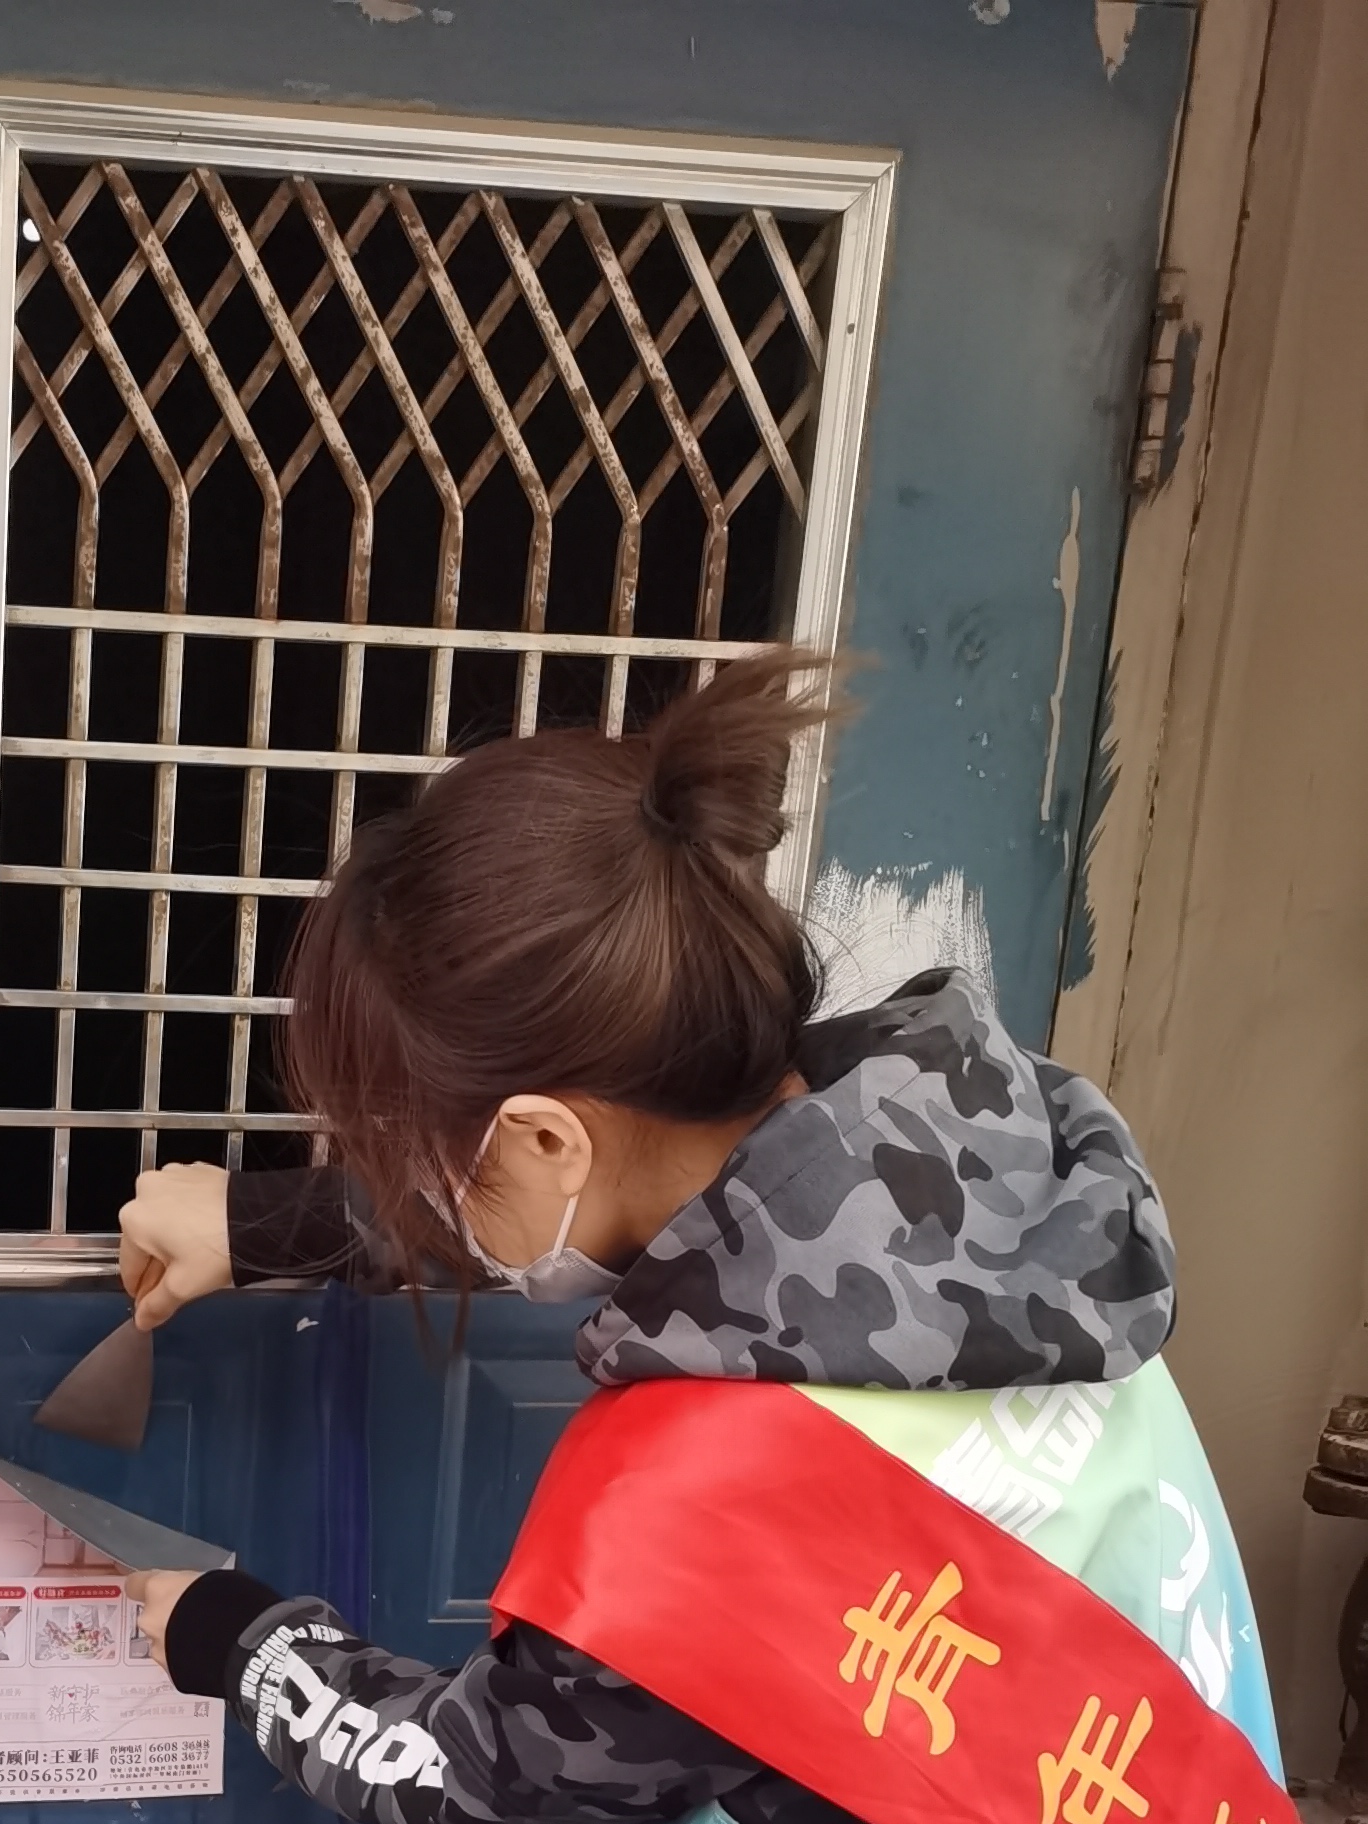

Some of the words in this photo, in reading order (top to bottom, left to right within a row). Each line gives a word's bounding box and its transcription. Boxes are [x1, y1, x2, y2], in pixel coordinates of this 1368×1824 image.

[241, 1625, 296, 1700] UNIFORM
[256, 1682, 280, 1752] FASHIO
[110, 1754, 141, 1765] 0532
[149, 1753, 178, 1764] 6608
[149, 1742, 178, 1753] 6608
